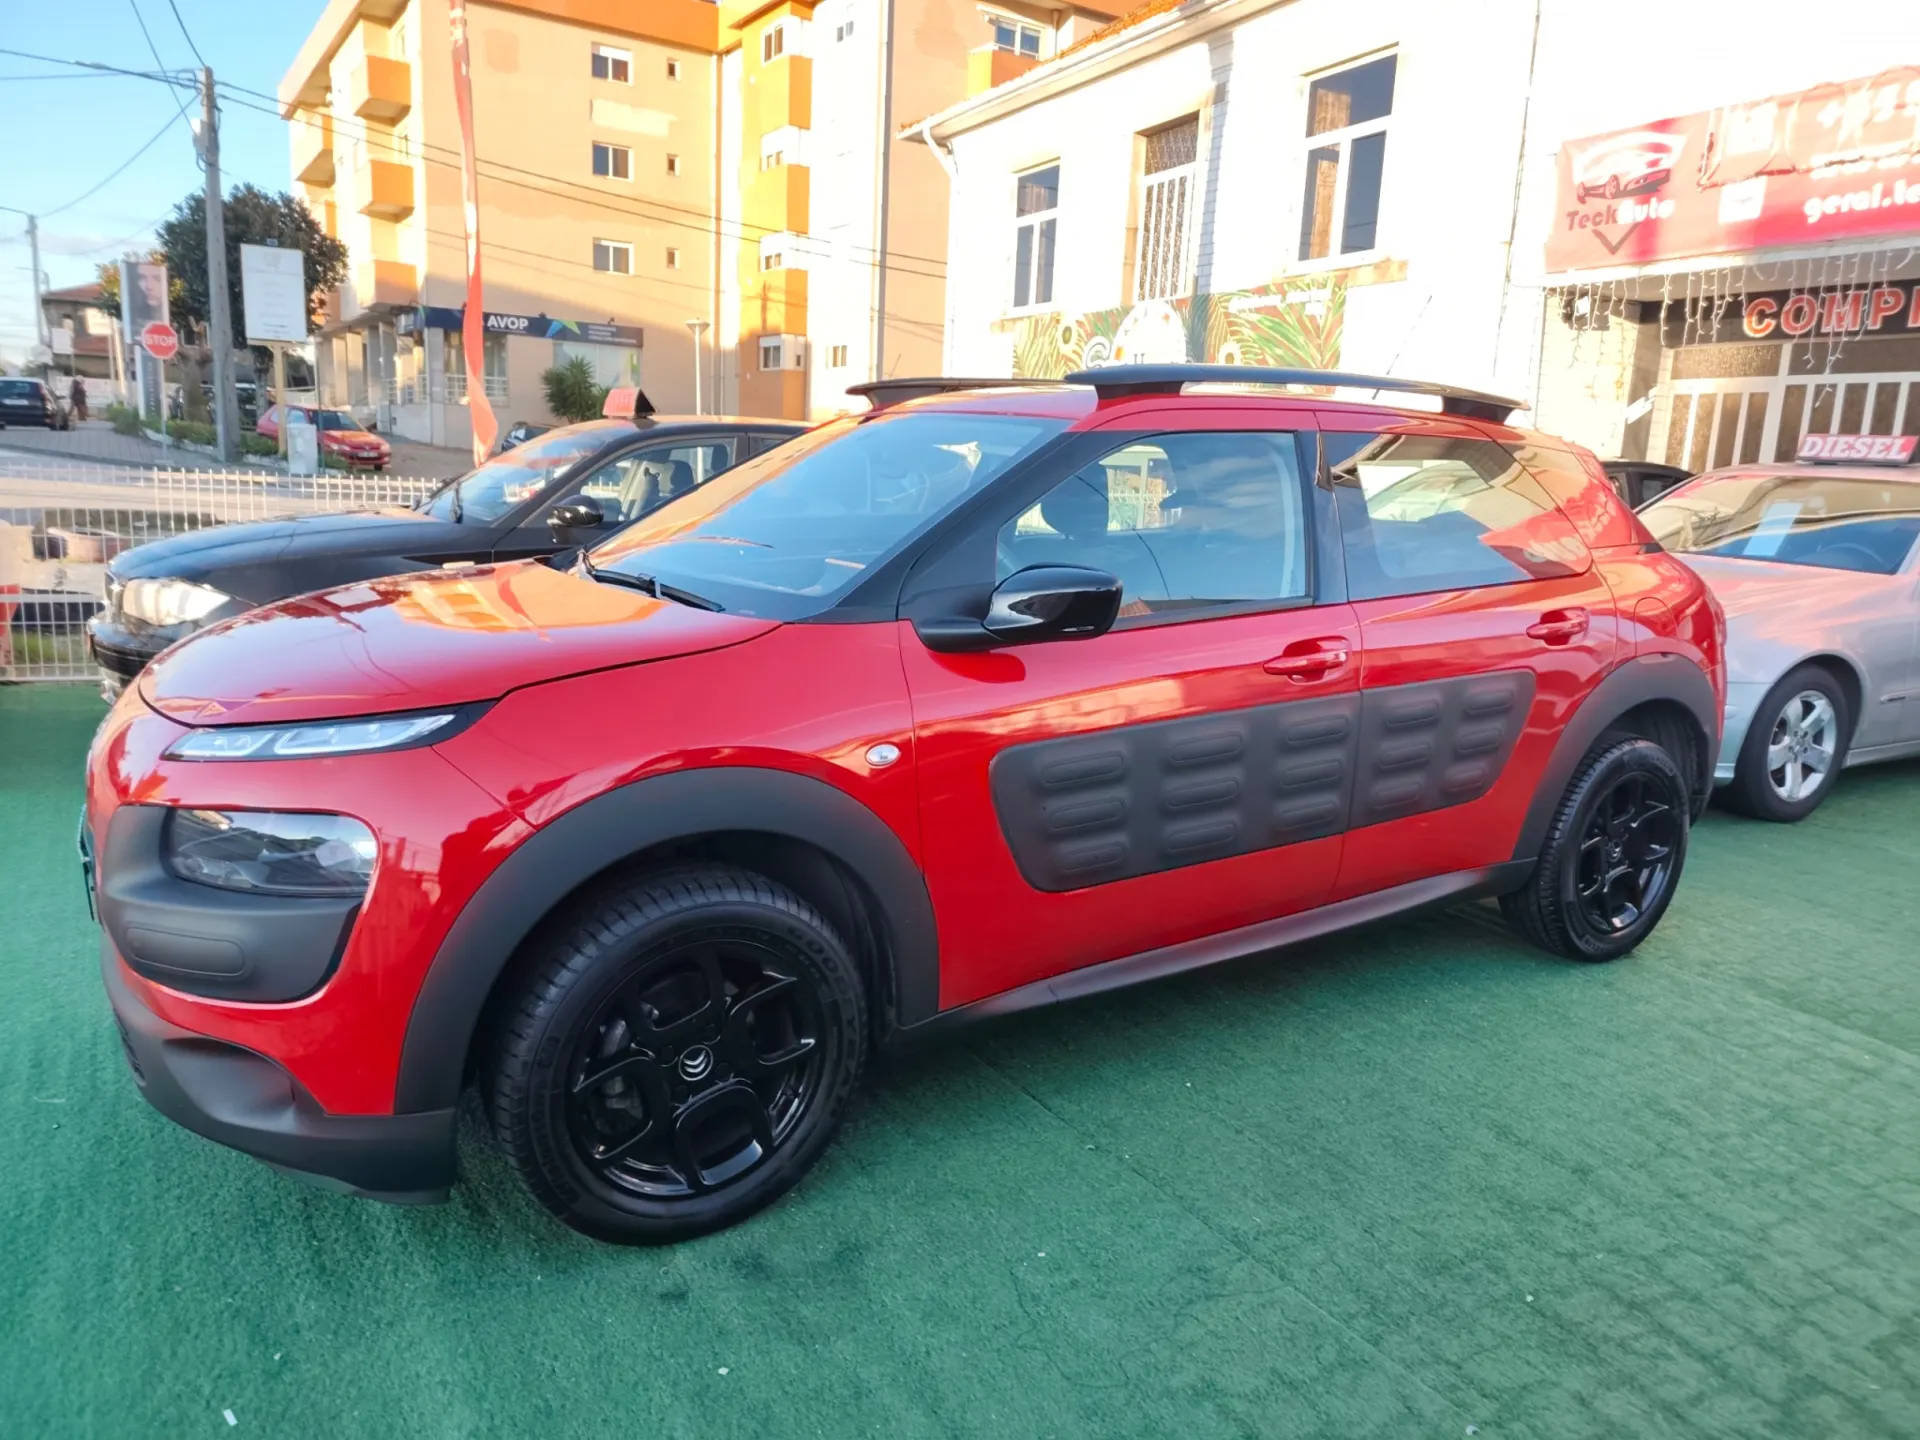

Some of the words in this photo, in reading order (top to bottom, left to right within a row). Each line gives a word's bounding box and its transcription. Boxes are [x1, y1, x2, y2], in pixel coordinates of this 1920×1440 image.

[487, 315, 528, 330] AVOP
[145, 334, 176, 347] STOP
[1799, 436, 1910, 461] DIESEL
